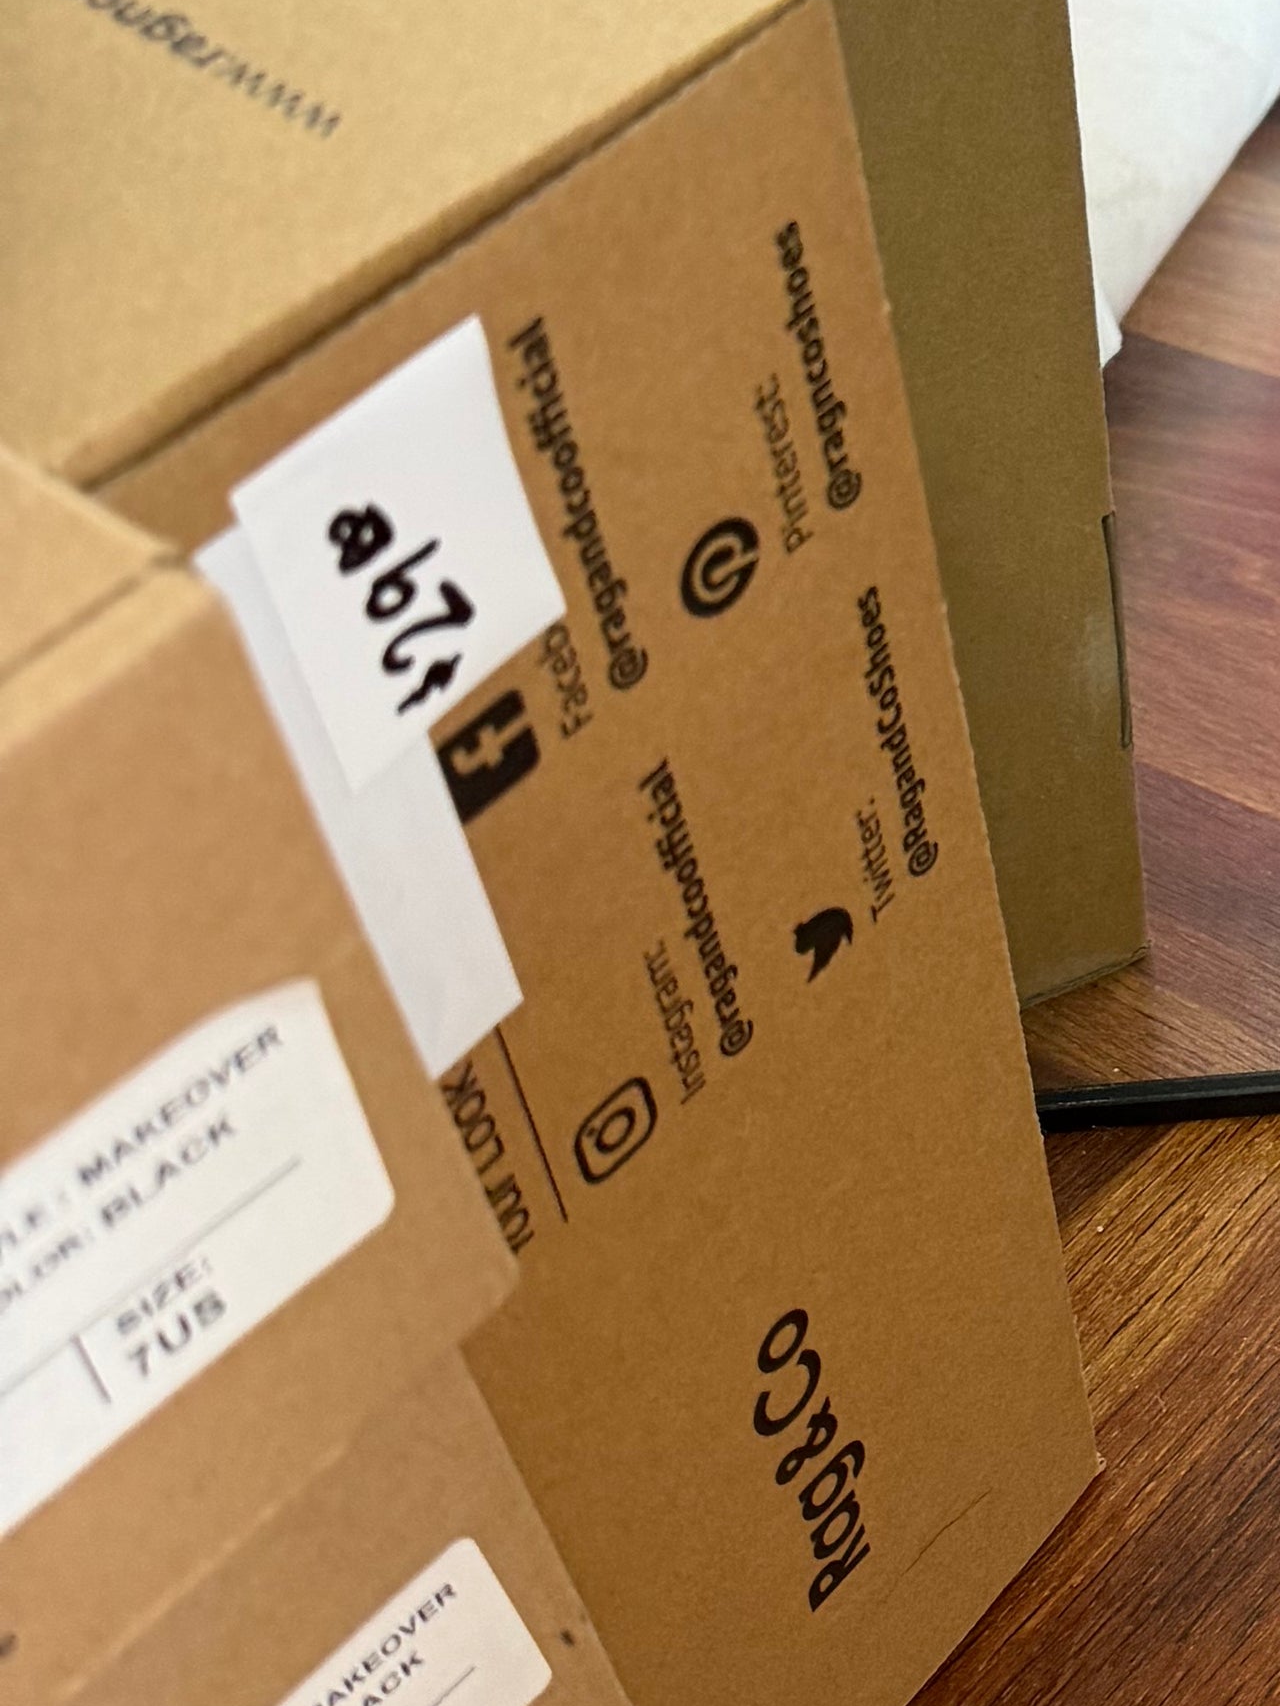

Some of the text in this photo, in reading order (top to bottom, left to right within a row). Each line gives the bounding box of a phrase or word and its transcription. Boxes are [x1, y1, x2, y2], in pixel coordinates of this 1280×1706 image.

[774, 218, 864, 512] @ragncoshoes
[509, 315, 649, 693] @ragandcoofficial
[754, 373, 810, 557] Pinterest:
[856, 584, 939, 878] @RagandCoShoes
[638, 756, 753, 1058] @ragandcoofficial
[853, 796, 899, 927] Twitter:
[77, 1024, 284, 1186] MAKEOVER
[641, 937, 707, 1105] Instagram:
[101, 1111, 236, 1228] BLACK
[116, 1256, 214, 1336] SIZE:
[127, 1291, 229, 1379] 7US
[752, 1308, 873, 1614] Rag&Co
